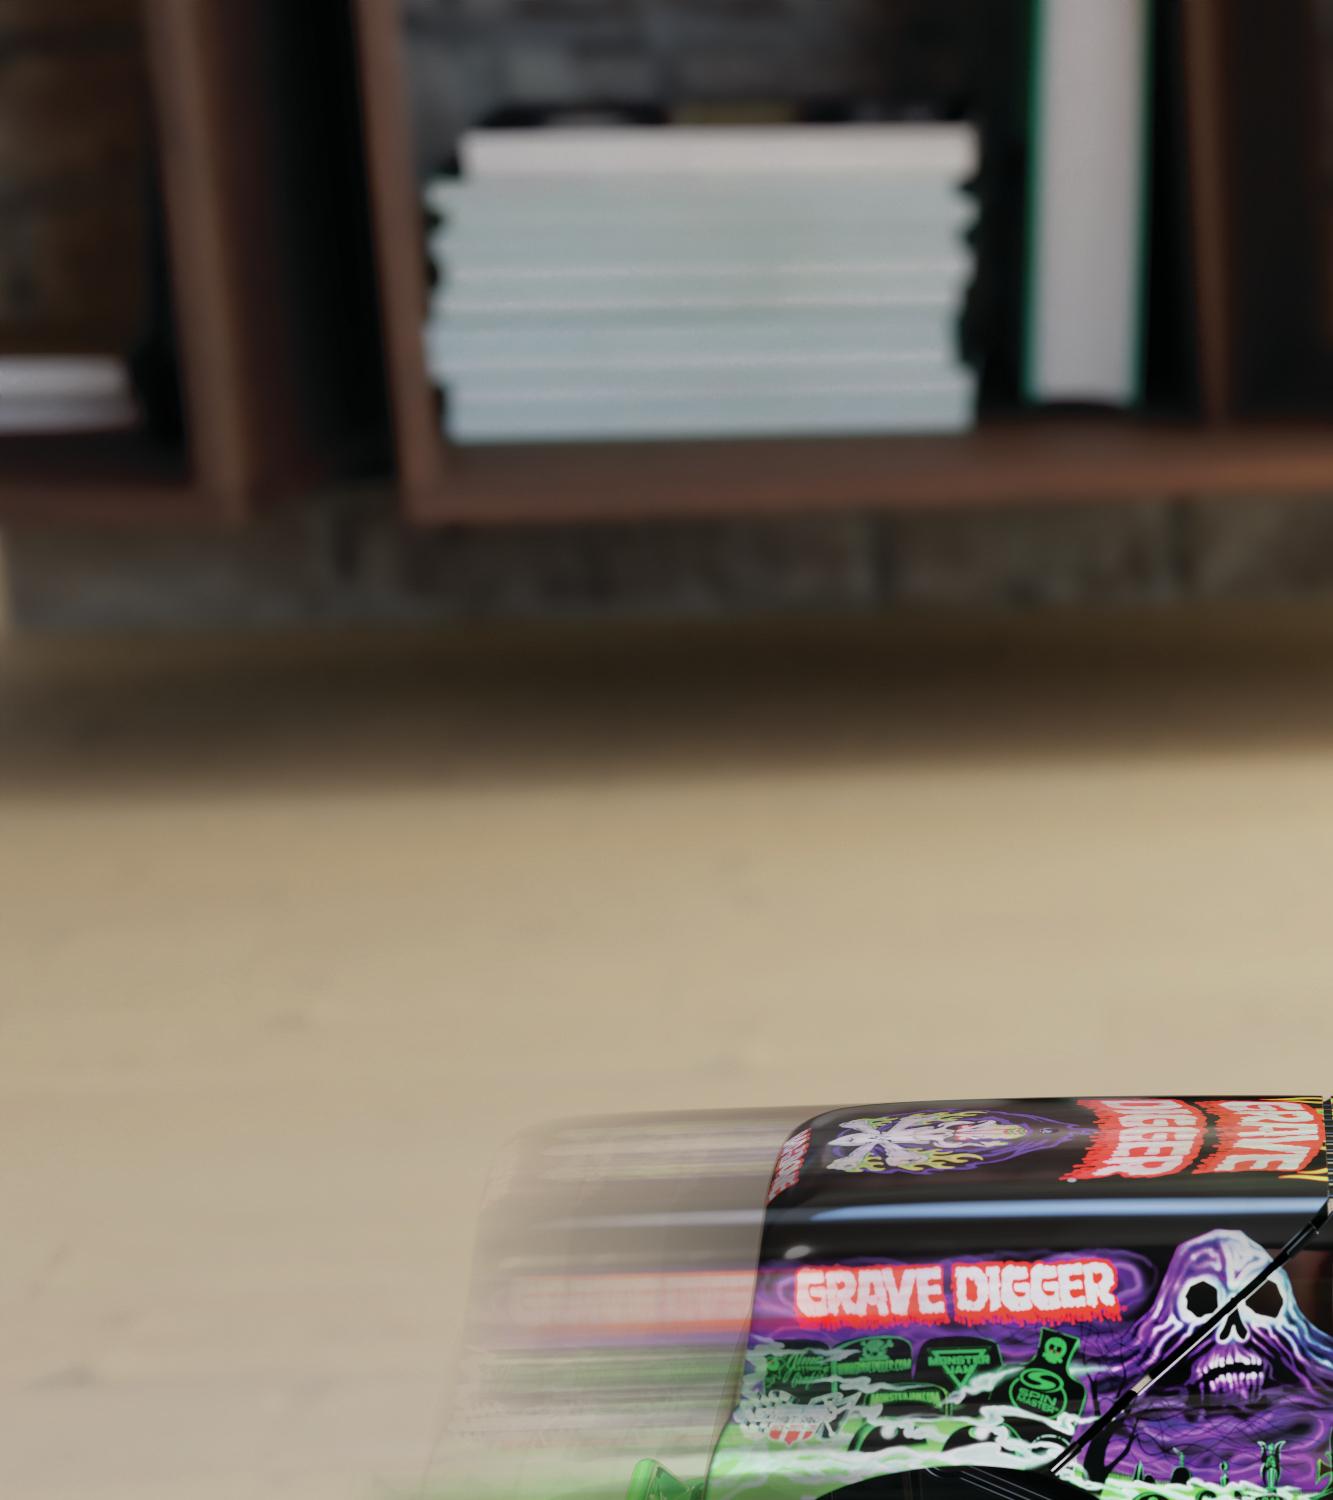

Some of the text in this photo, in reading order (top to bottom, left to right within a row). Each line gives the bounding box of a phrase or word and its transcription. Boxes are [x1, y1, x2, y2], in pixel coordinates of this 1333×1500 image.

[1092, 1099, 1201, 1176] DIGGER
[1213, 1100, 1320, 1172] GRAVE
[796, 1261, 1117, 1318] GRAVE DIGGER
[927, 1354, 991, 1367] MONSTER
[1018, 1387, 1057, 1406] SPIN
